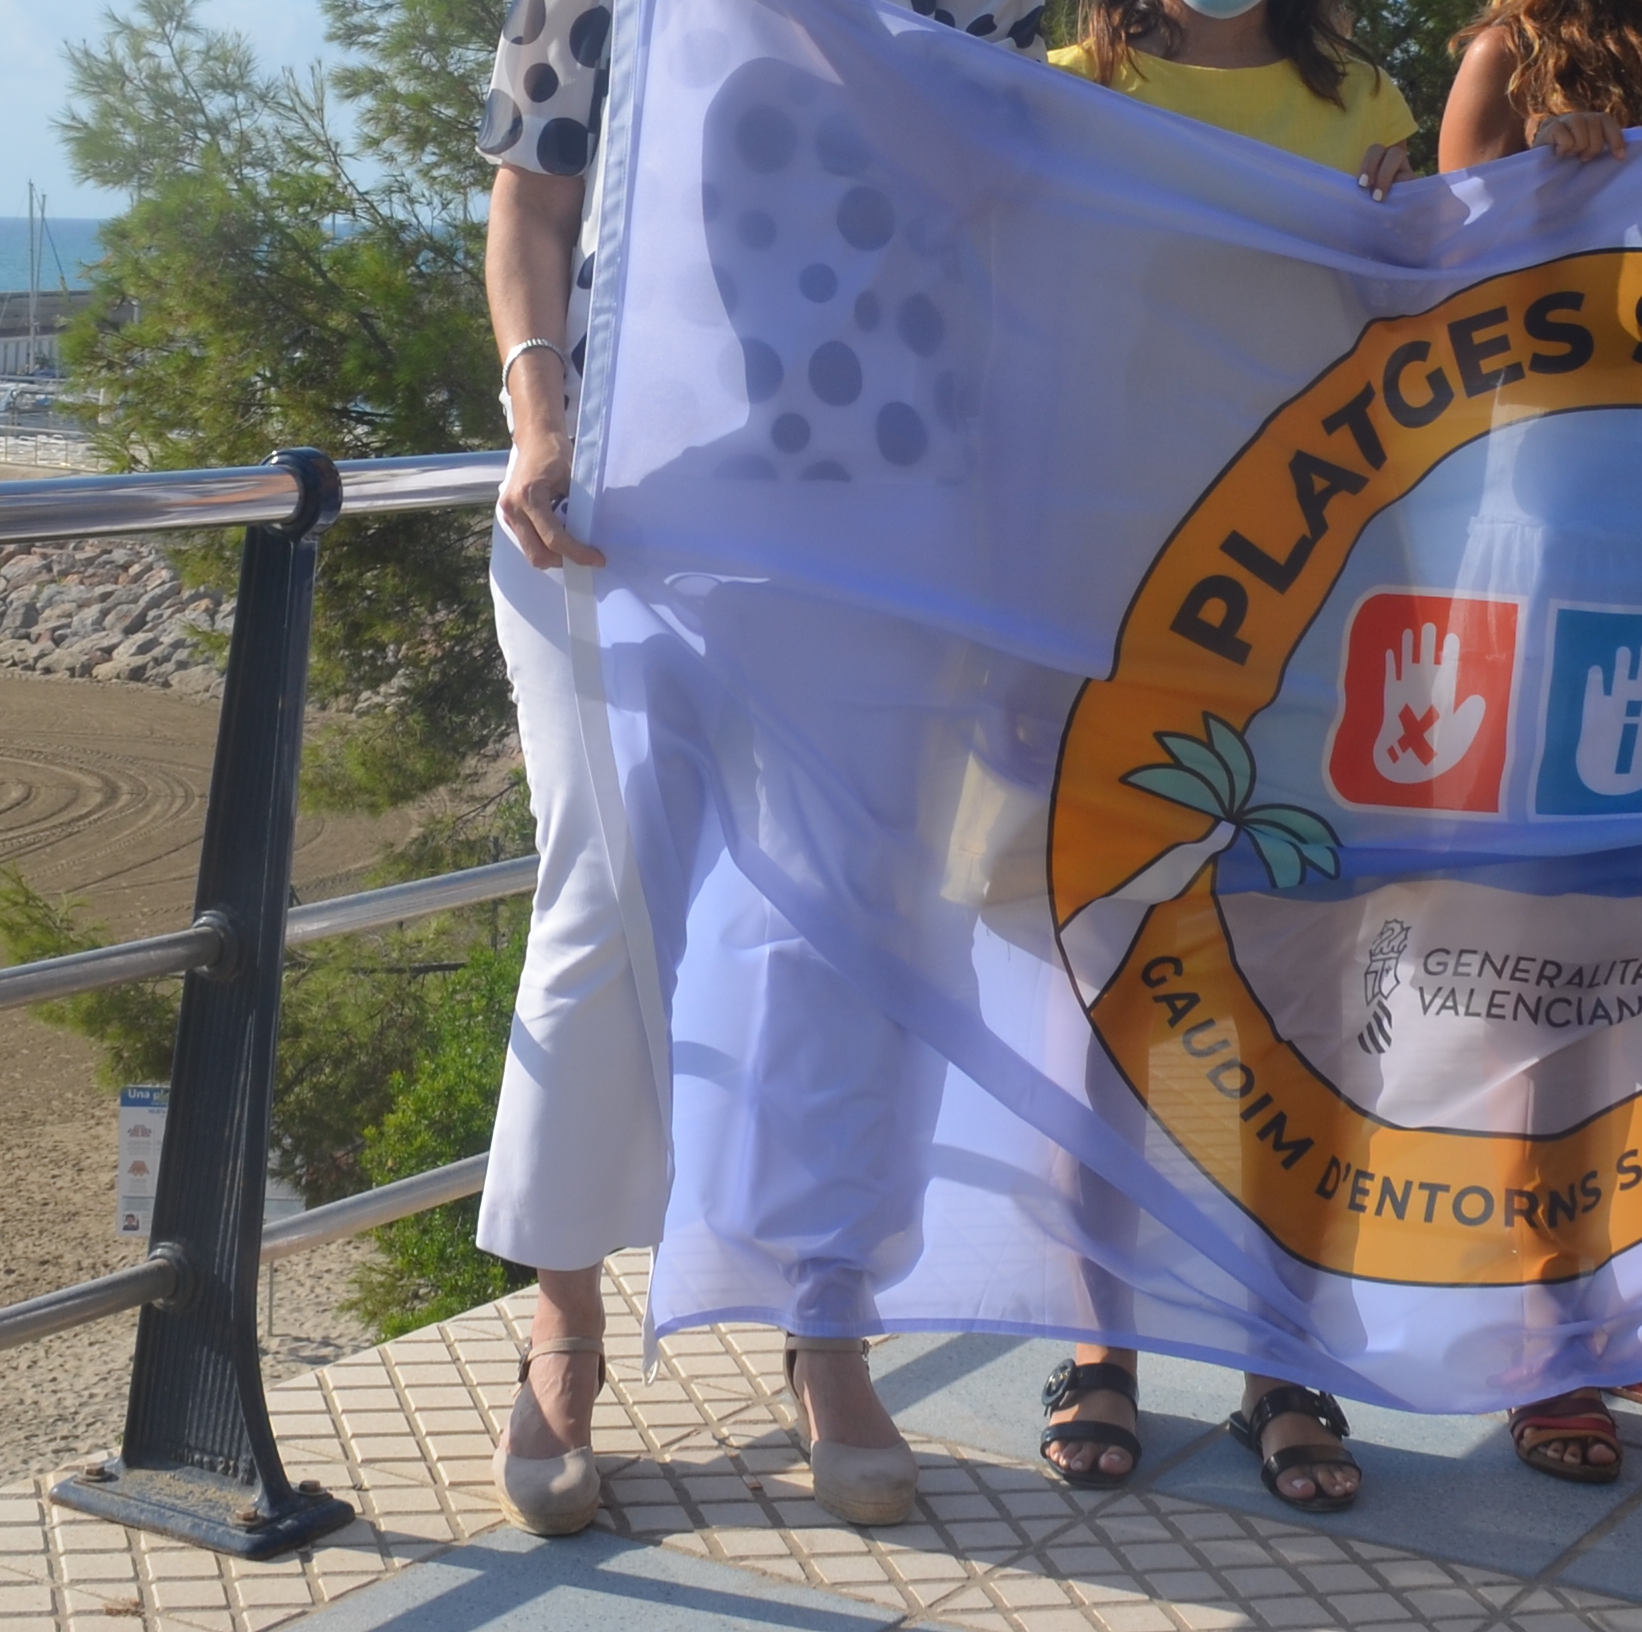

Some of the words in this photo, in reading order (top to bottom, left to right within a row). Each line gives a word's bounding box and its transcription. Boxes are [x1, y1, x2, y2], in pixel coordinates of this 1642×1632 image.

[1169, 290, 1594, 666] PLATGES
[1140, 955, 1314, 1170] GAUDIM
[1314, 1155, 1602, 1228] D'ENTORNS
